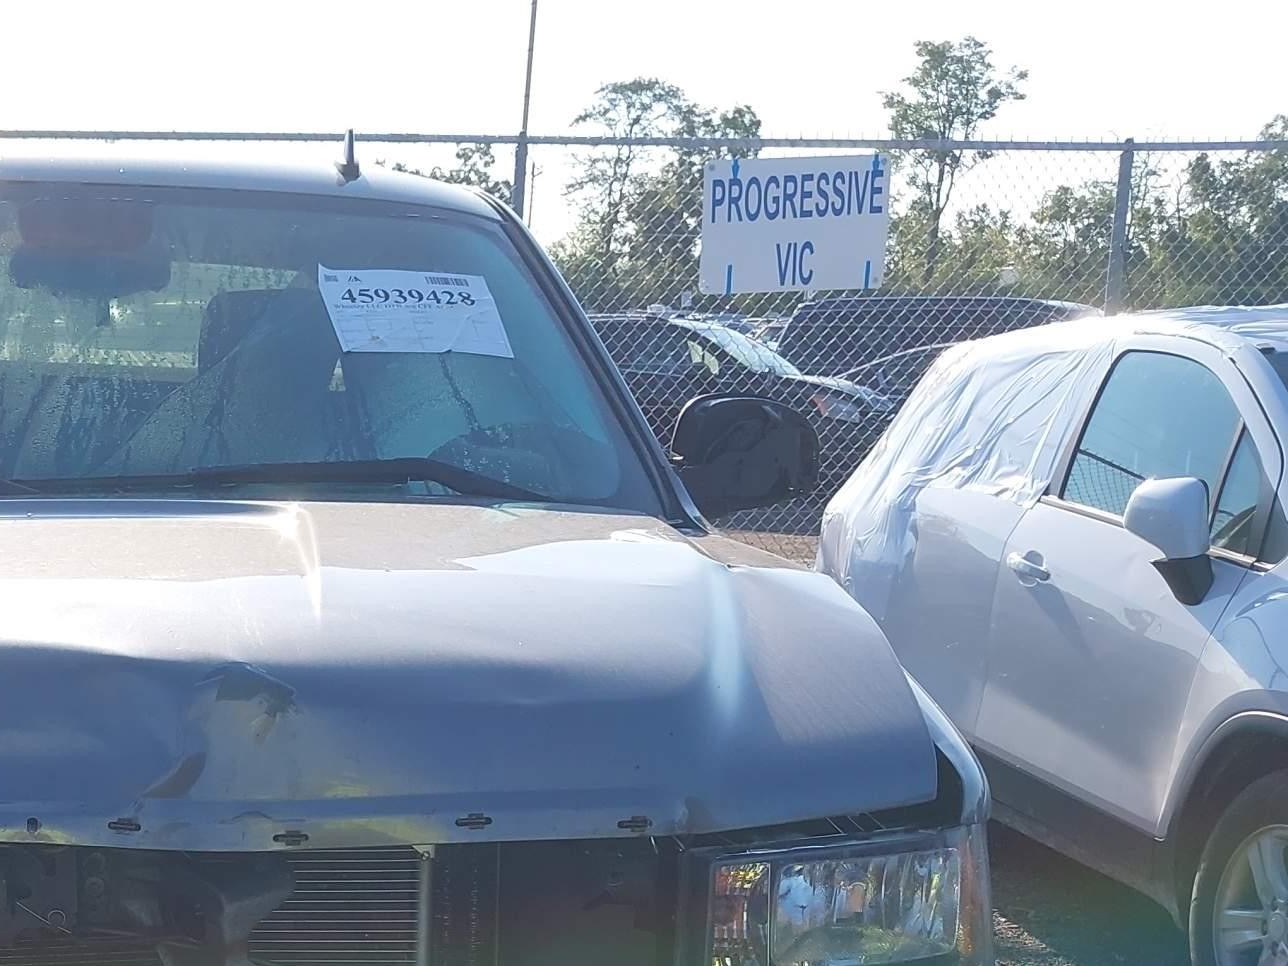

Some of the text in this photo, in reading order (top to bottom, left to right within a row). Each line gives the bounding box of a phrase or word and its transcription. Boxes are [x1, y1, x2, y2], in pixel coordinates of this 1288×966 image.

[712, 169, 884, 224] PROGRESSIVE
[776, 241, 814, 286] VIC
[341, 288, 476, 306] 45939428
